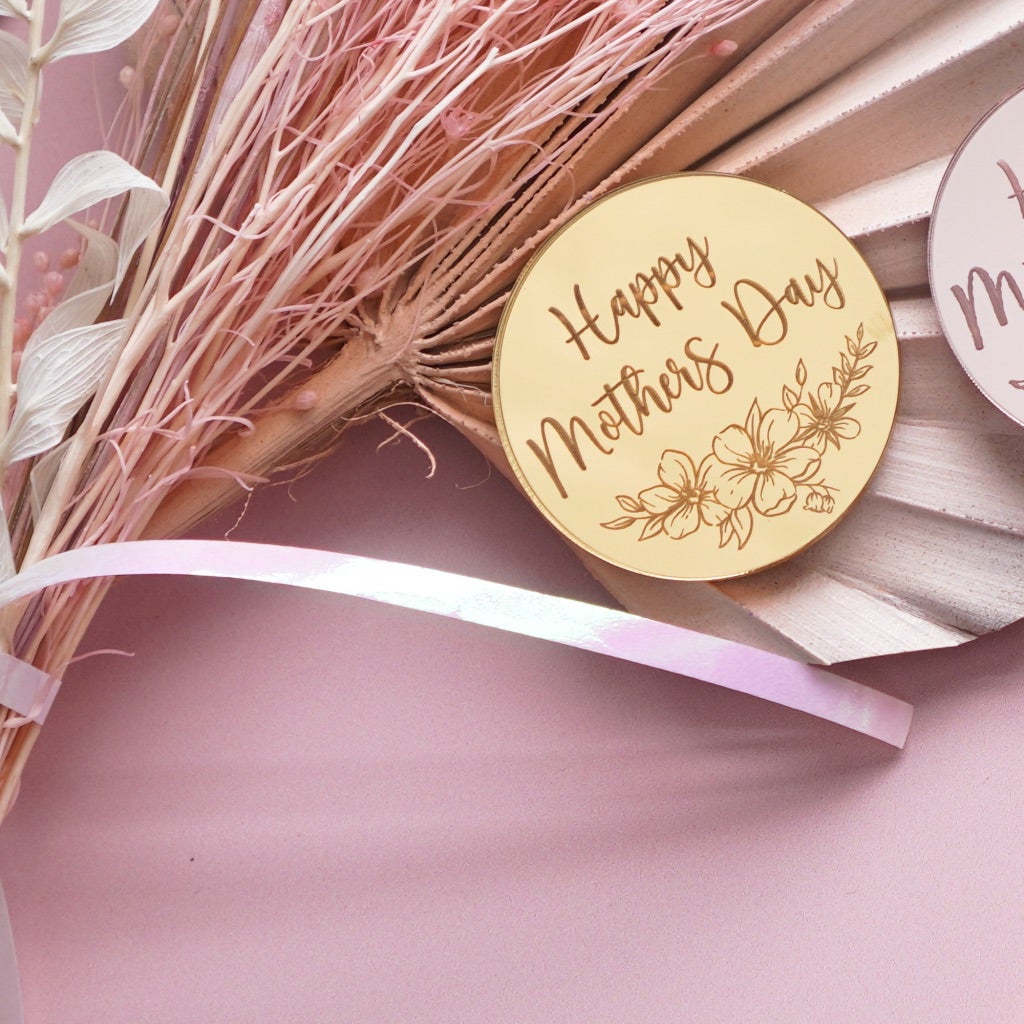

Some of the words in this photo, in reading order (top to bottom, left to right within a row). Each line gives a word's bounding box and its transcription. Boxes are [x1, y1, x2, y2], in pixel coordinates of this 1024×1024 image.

[526, 337, 734, 499] Mothers
[720, 257, 846, 347] Day
[548, 236, 717, 360] Happy
